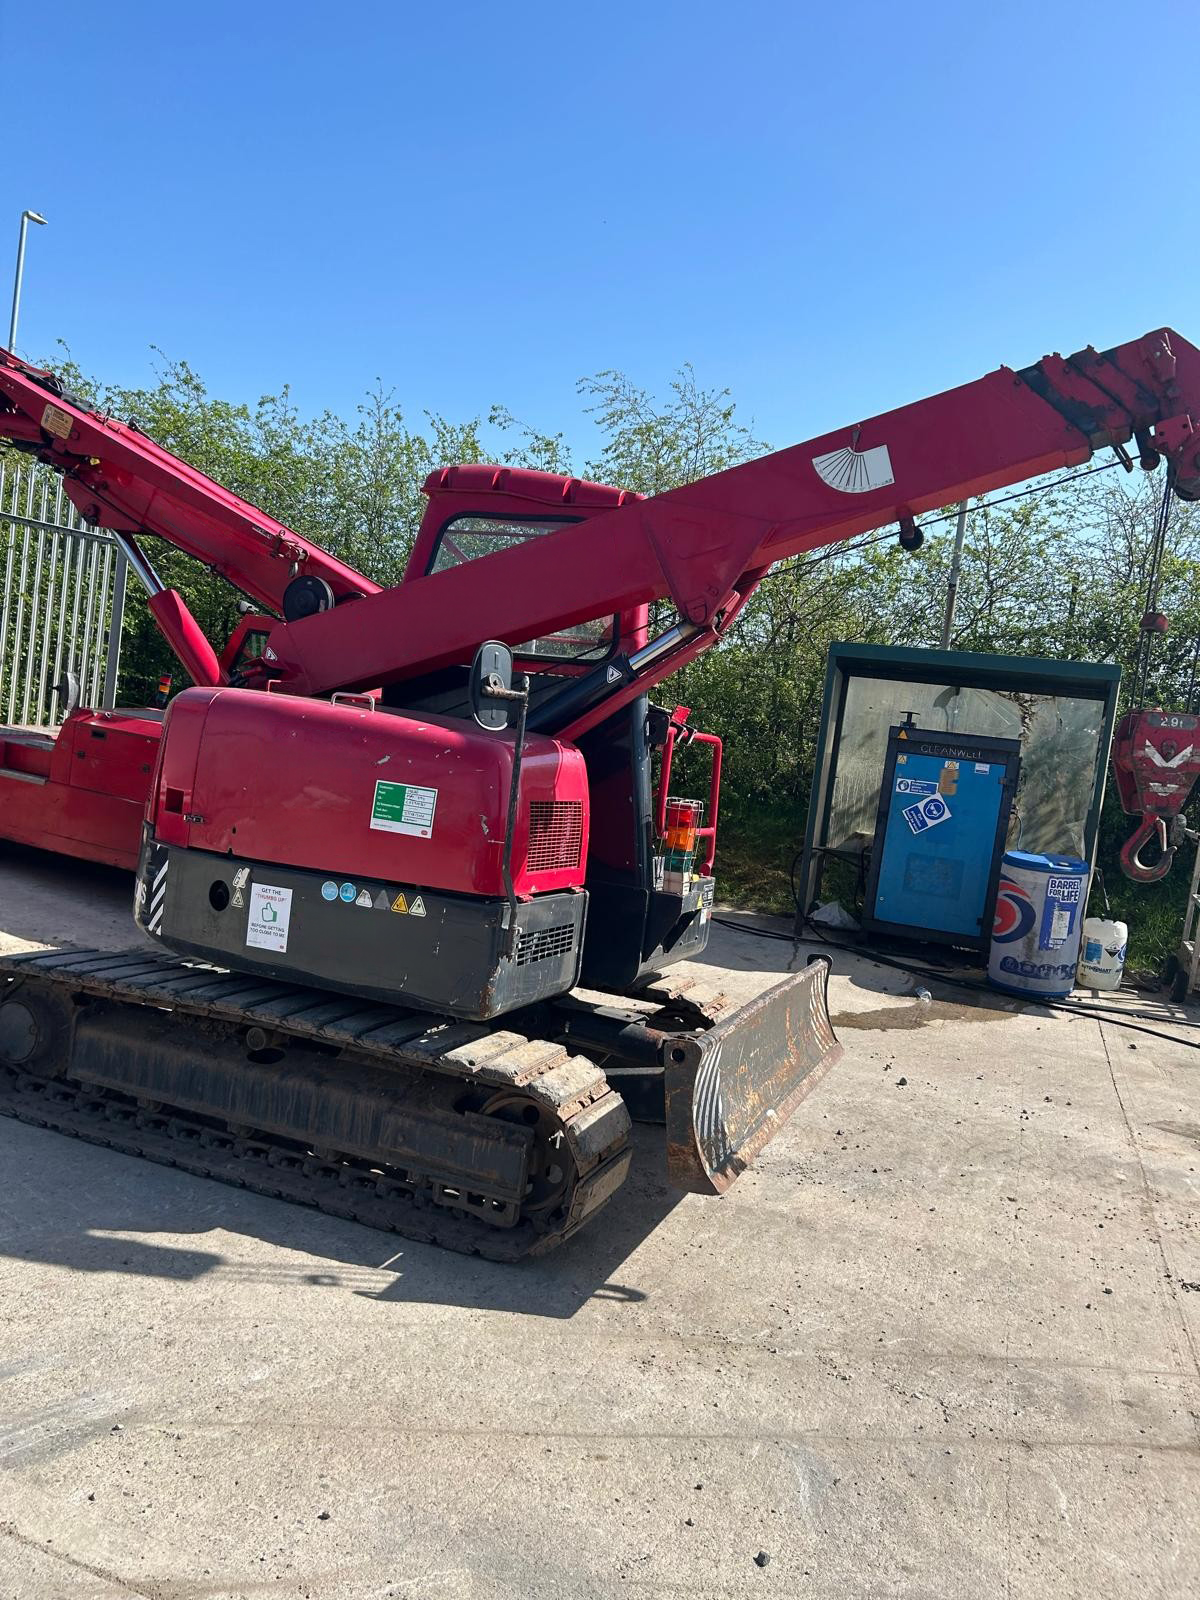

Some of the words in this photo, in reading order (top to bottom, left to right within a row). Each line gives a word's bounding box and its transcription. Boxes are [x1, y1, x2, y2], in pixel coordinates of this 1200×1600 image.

[1050, 879, 1080, 890] BARREL
[1049, 888, 1062, 896] FOR
[1061, 889, 1079, 902] LIFE
